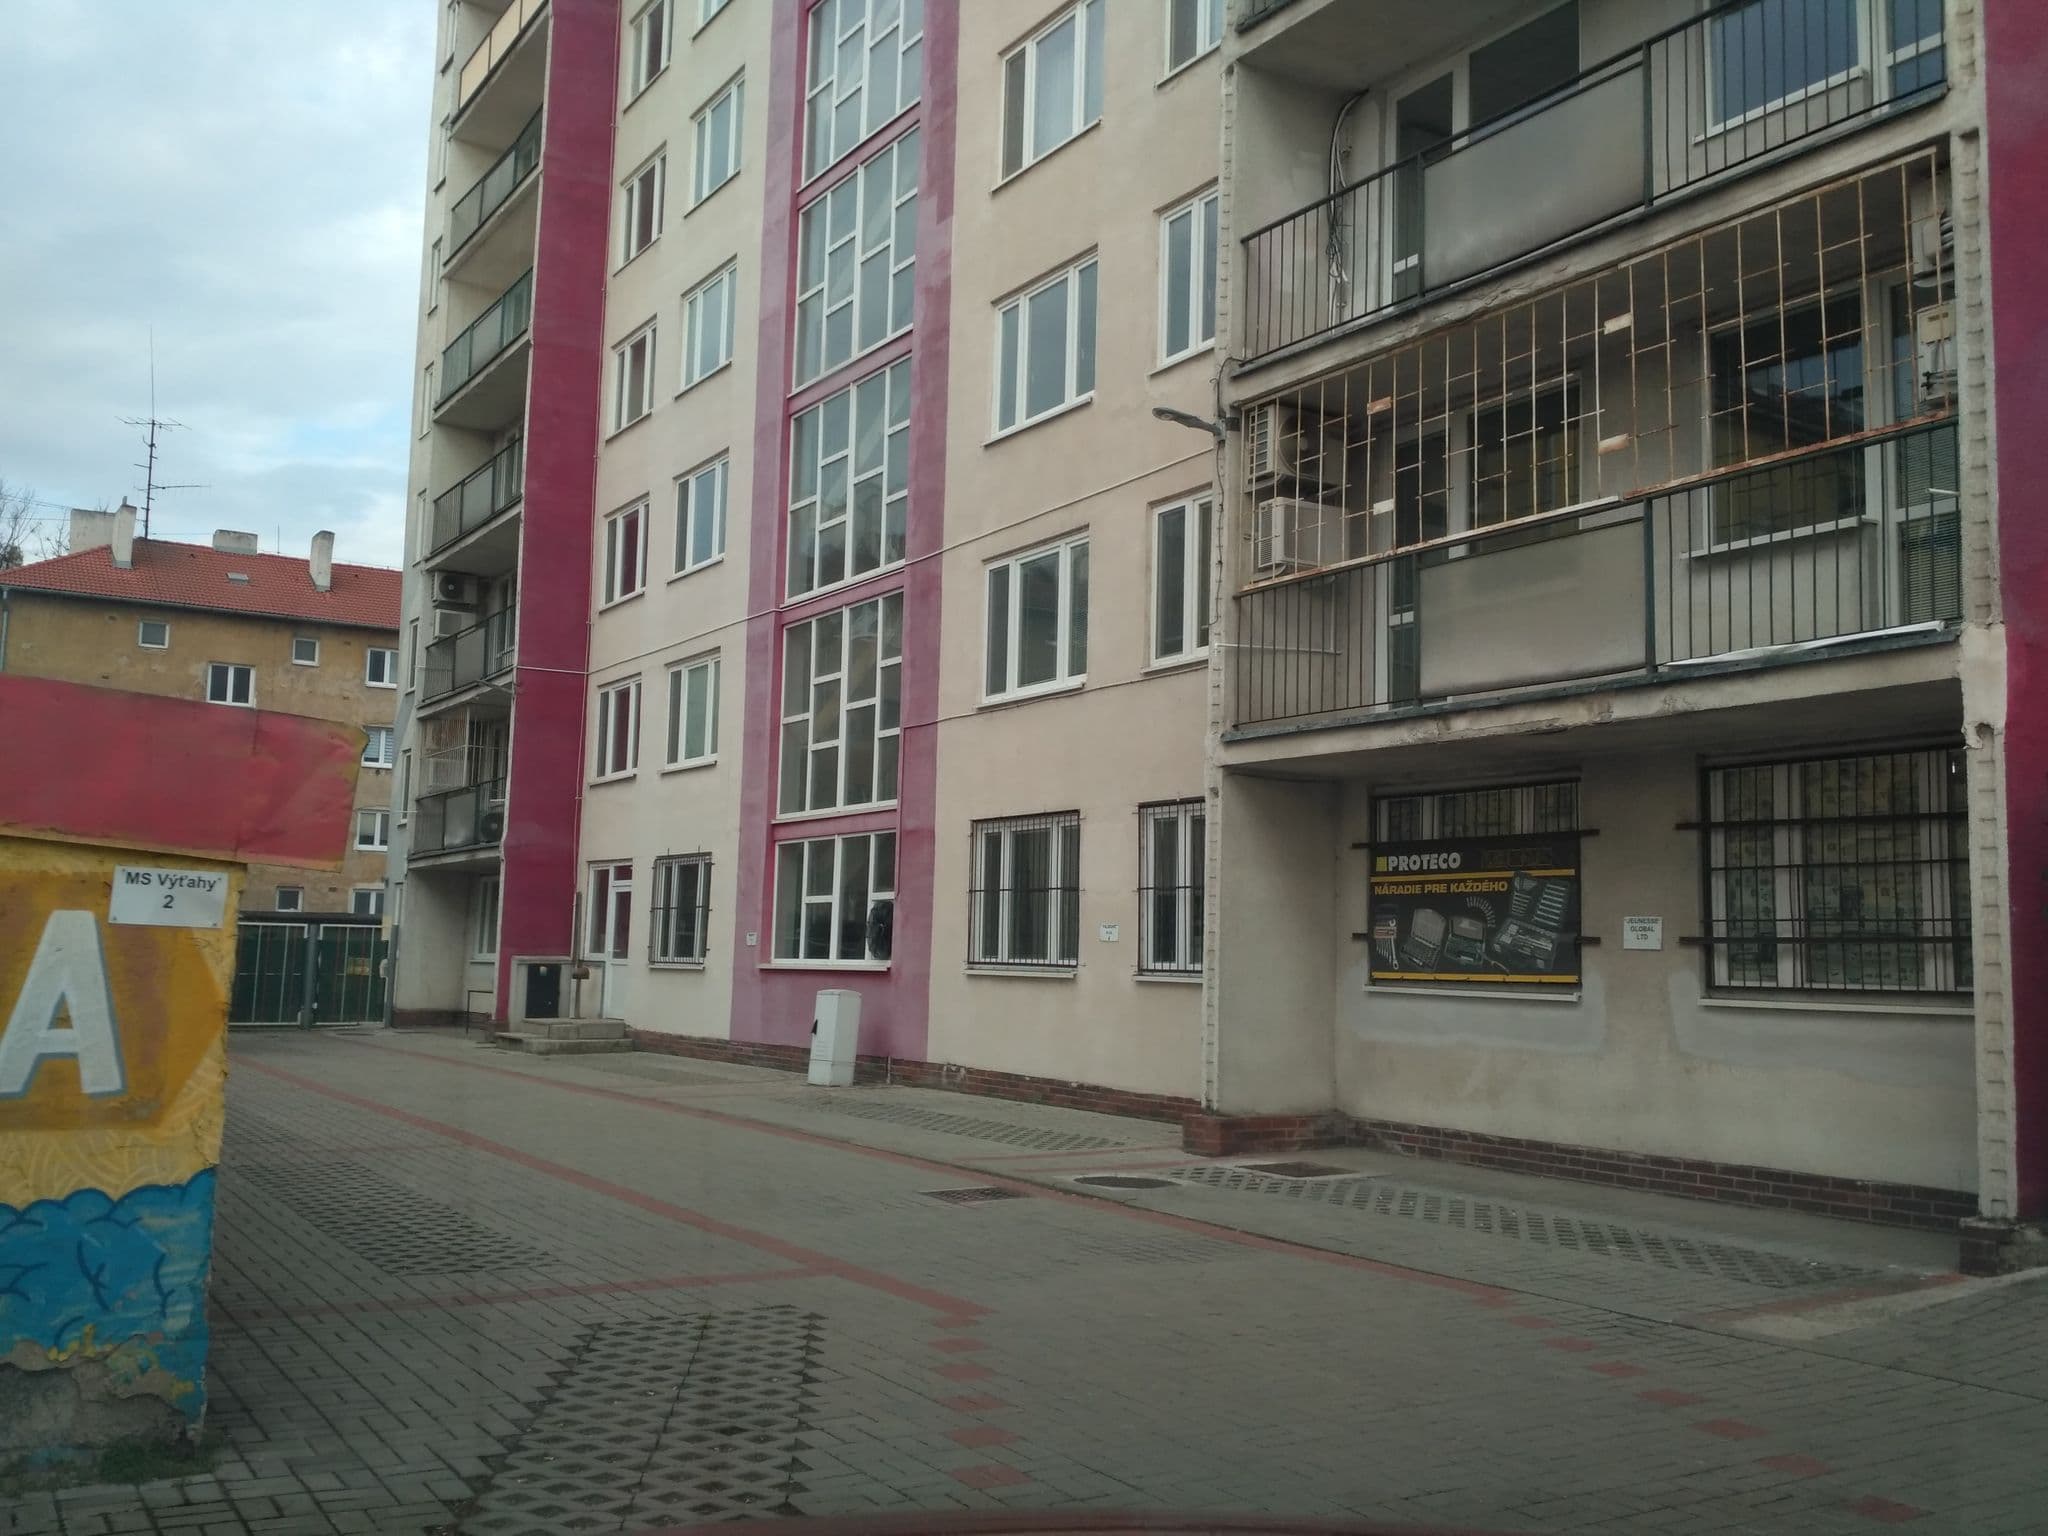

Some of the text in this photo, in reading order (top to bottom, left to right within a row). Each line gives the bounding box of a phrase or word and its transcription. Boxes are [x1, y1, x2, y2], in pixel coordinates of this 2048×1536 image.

[1388, 852, 1461, 872] PROTECO
[125, 871, 217, 892] MS Výťahy
[1374, 880, 1508, 896] NÁRADIE PRE KAŽDÉHO
[162, 894, 175, 909] 2
[0, 910, 126, 1098] A
